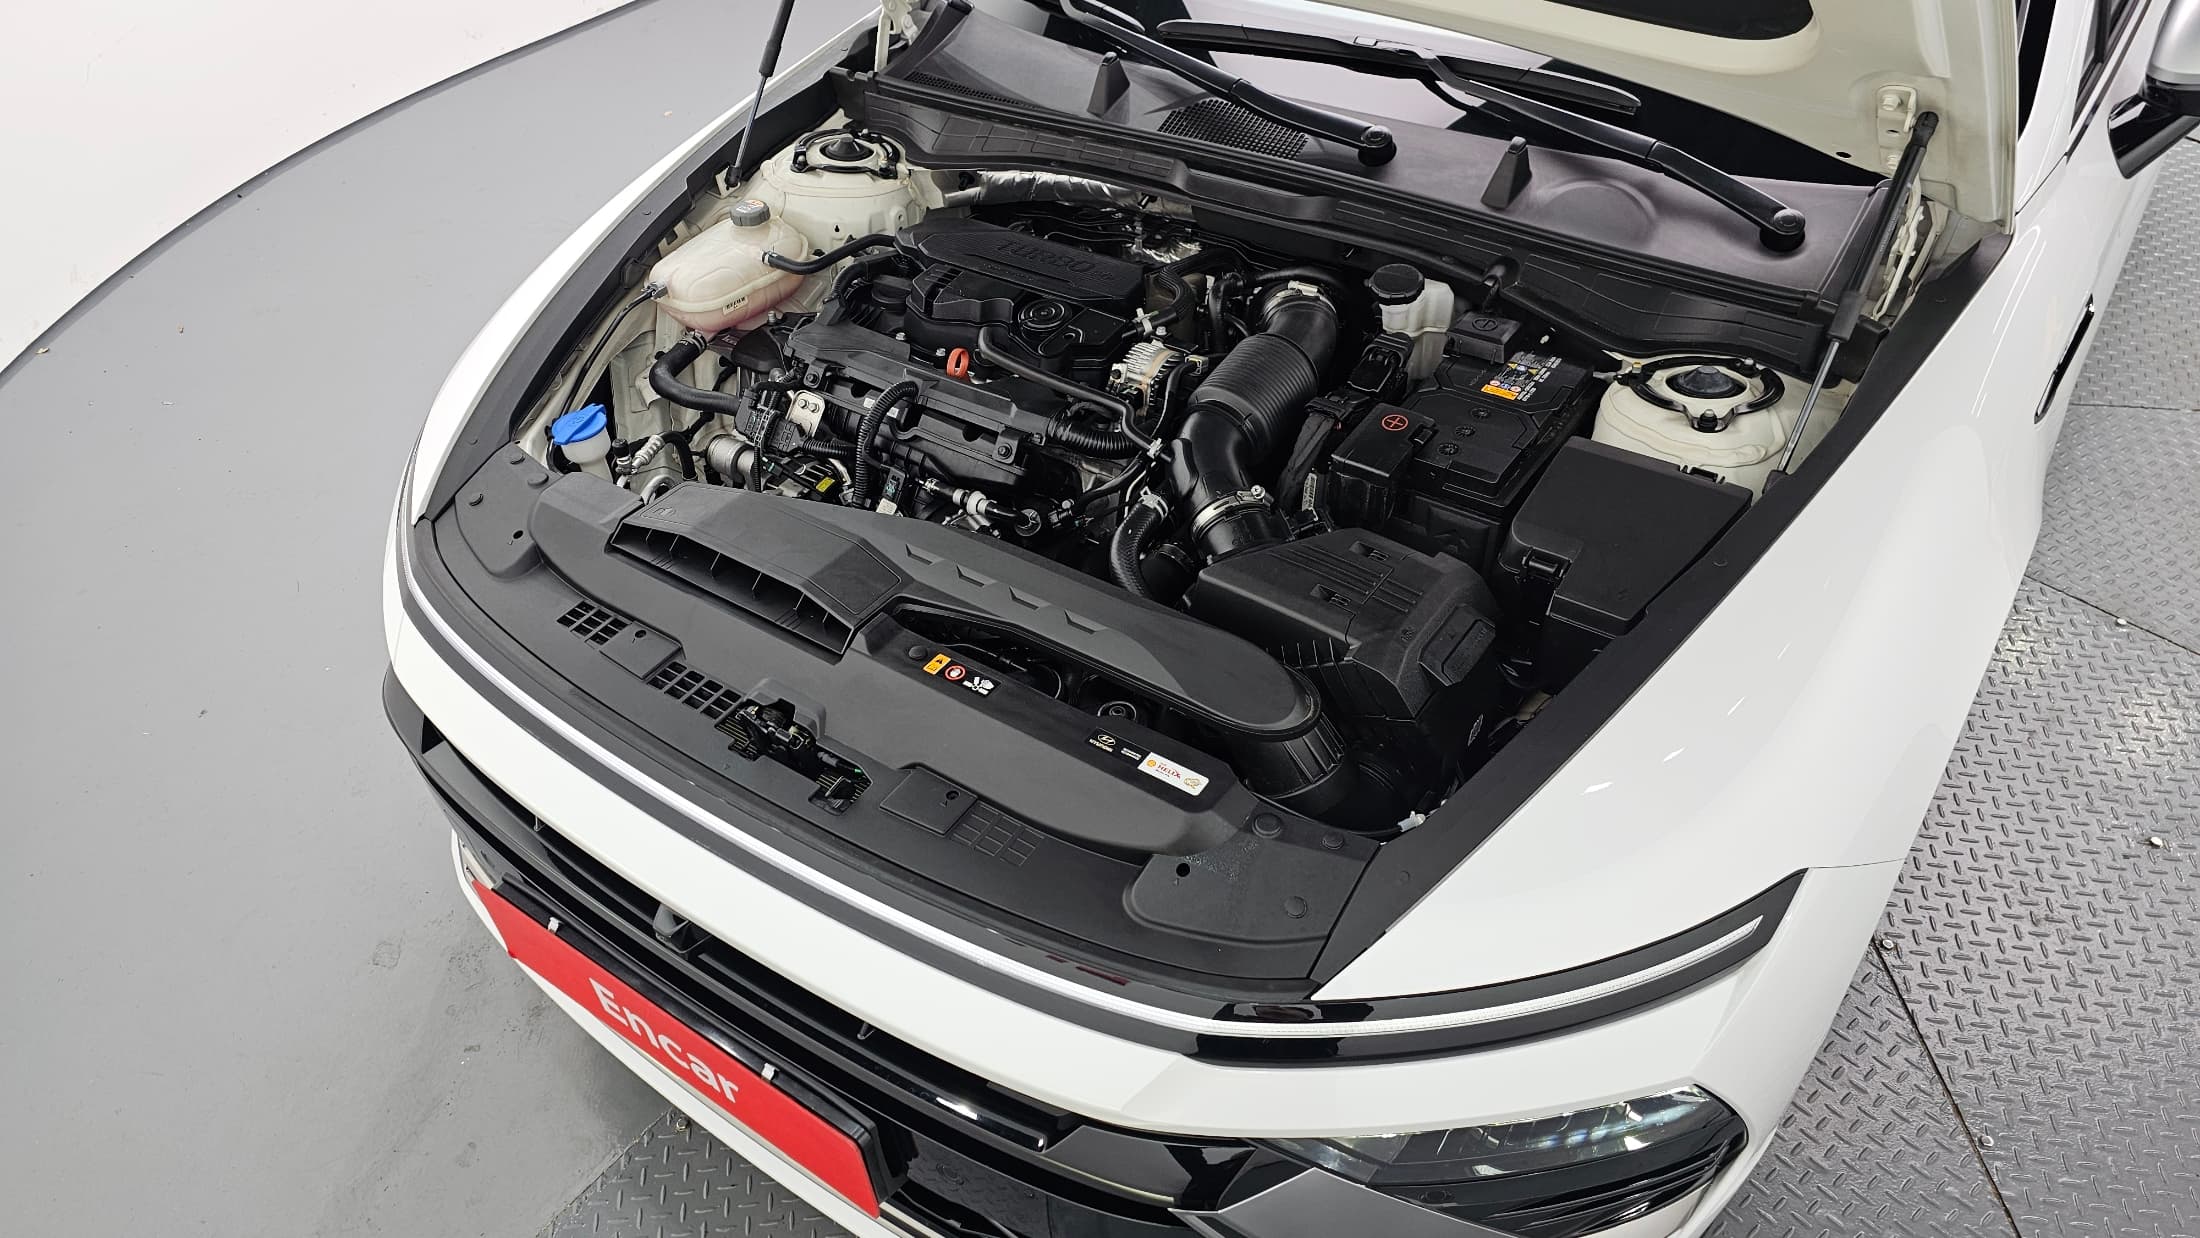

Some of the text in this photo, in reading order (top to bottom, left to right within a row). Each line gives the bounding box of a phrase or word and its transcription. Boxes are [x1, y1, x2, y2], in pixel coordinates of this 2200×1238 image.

[998, 241, 1096, 273] TURBO
[1157, 764, 1181, 779] HELIX
[589, 977, 739, 1103] Encar
